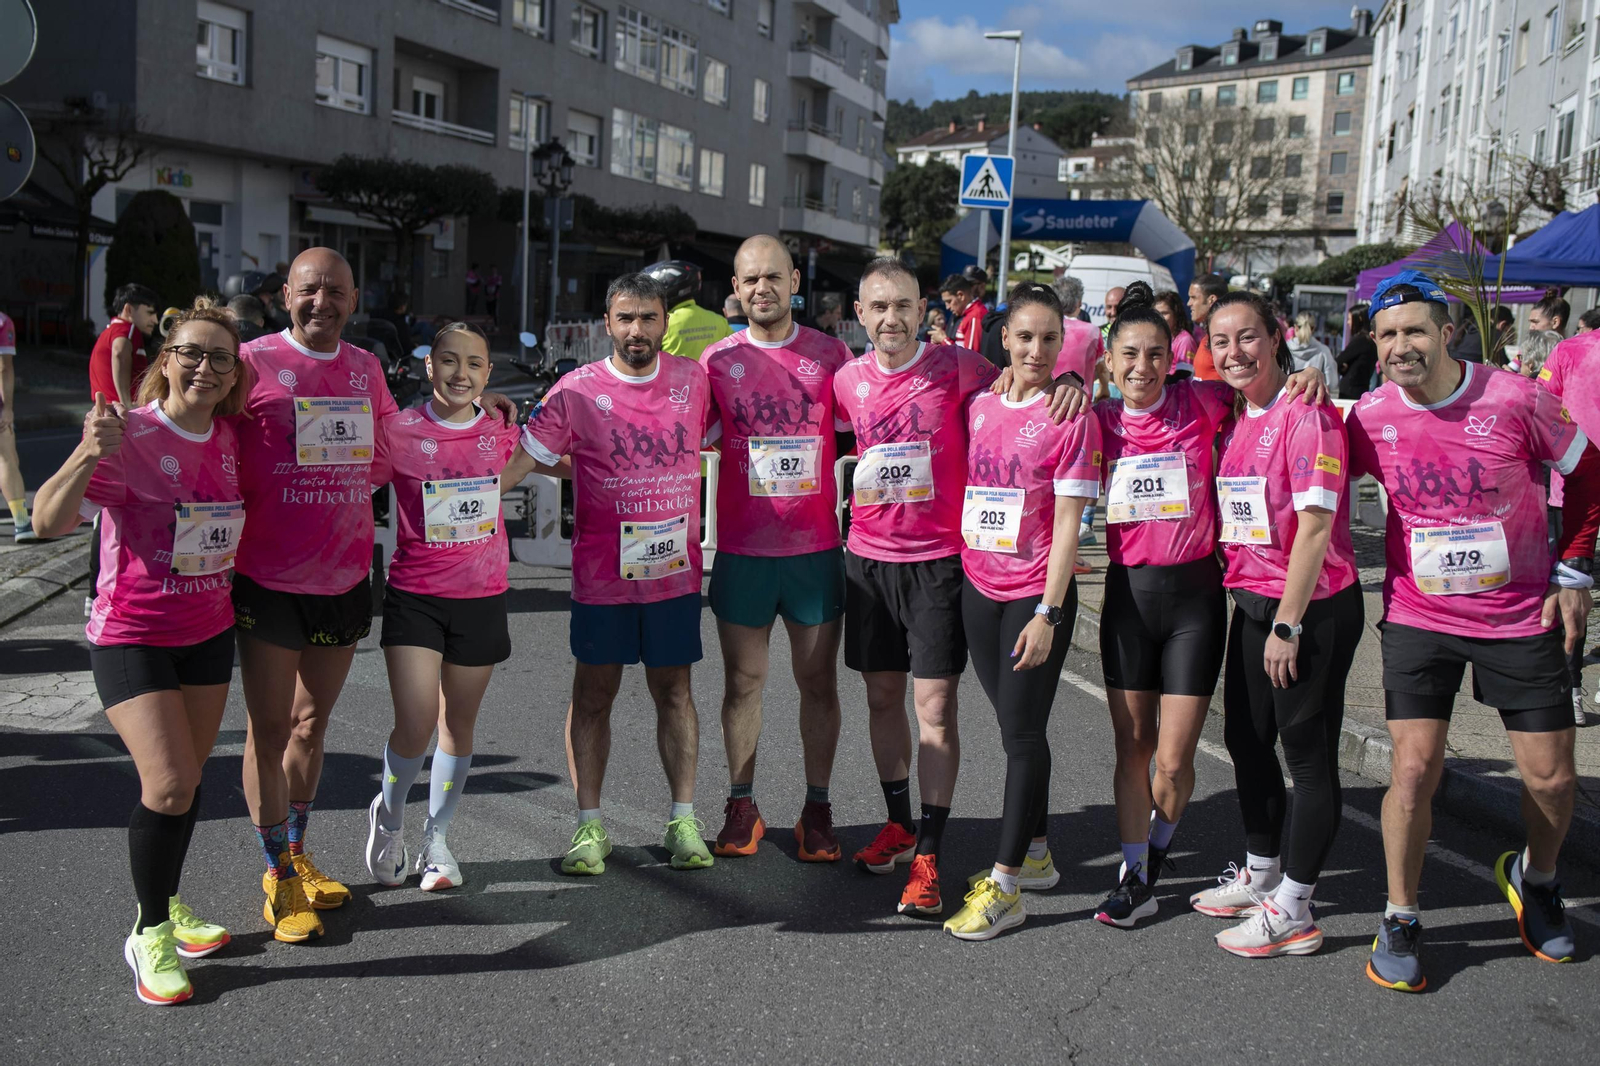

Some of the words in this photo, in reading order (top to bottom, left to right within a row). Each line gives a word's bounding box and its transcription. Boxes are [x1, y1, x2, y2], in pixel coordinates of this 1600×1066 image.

[156, 166, 193, 188] Kids
[1045, 215, 1118, 229] Saudeter
[335, 421, 346, 435] 5
[751, 440, 760, 449] III
[780, 458, 800, 471] 87
[880, 464, 912, 480] 202
[299, 476, 326, 487] contra
[602, 478, 620, 488] III
[620, 476, 656, 487] Carreira
[656, 471, 674, 487] pola
[1132, 478, 1164, 493] 201
[282, 488, 370, 504] Barbadás
[628, 487, 652, 498] contra
[458, 500, 479, 514] 42
[616, 494, 694, 514] Barbadás
[1231, 502, 1252, 516] 338
[980, 510, 1006, 526] 203
[210, 528, 227, 543] 41
[654, 526, 672, 535] BARBADÁS
[1414, 532, 1426, 542] III
[1466, 526, 1494, 534] IGUALDADE
[650, 540, 674, 556] 180
[1445, 550, 1481, 566] 179
